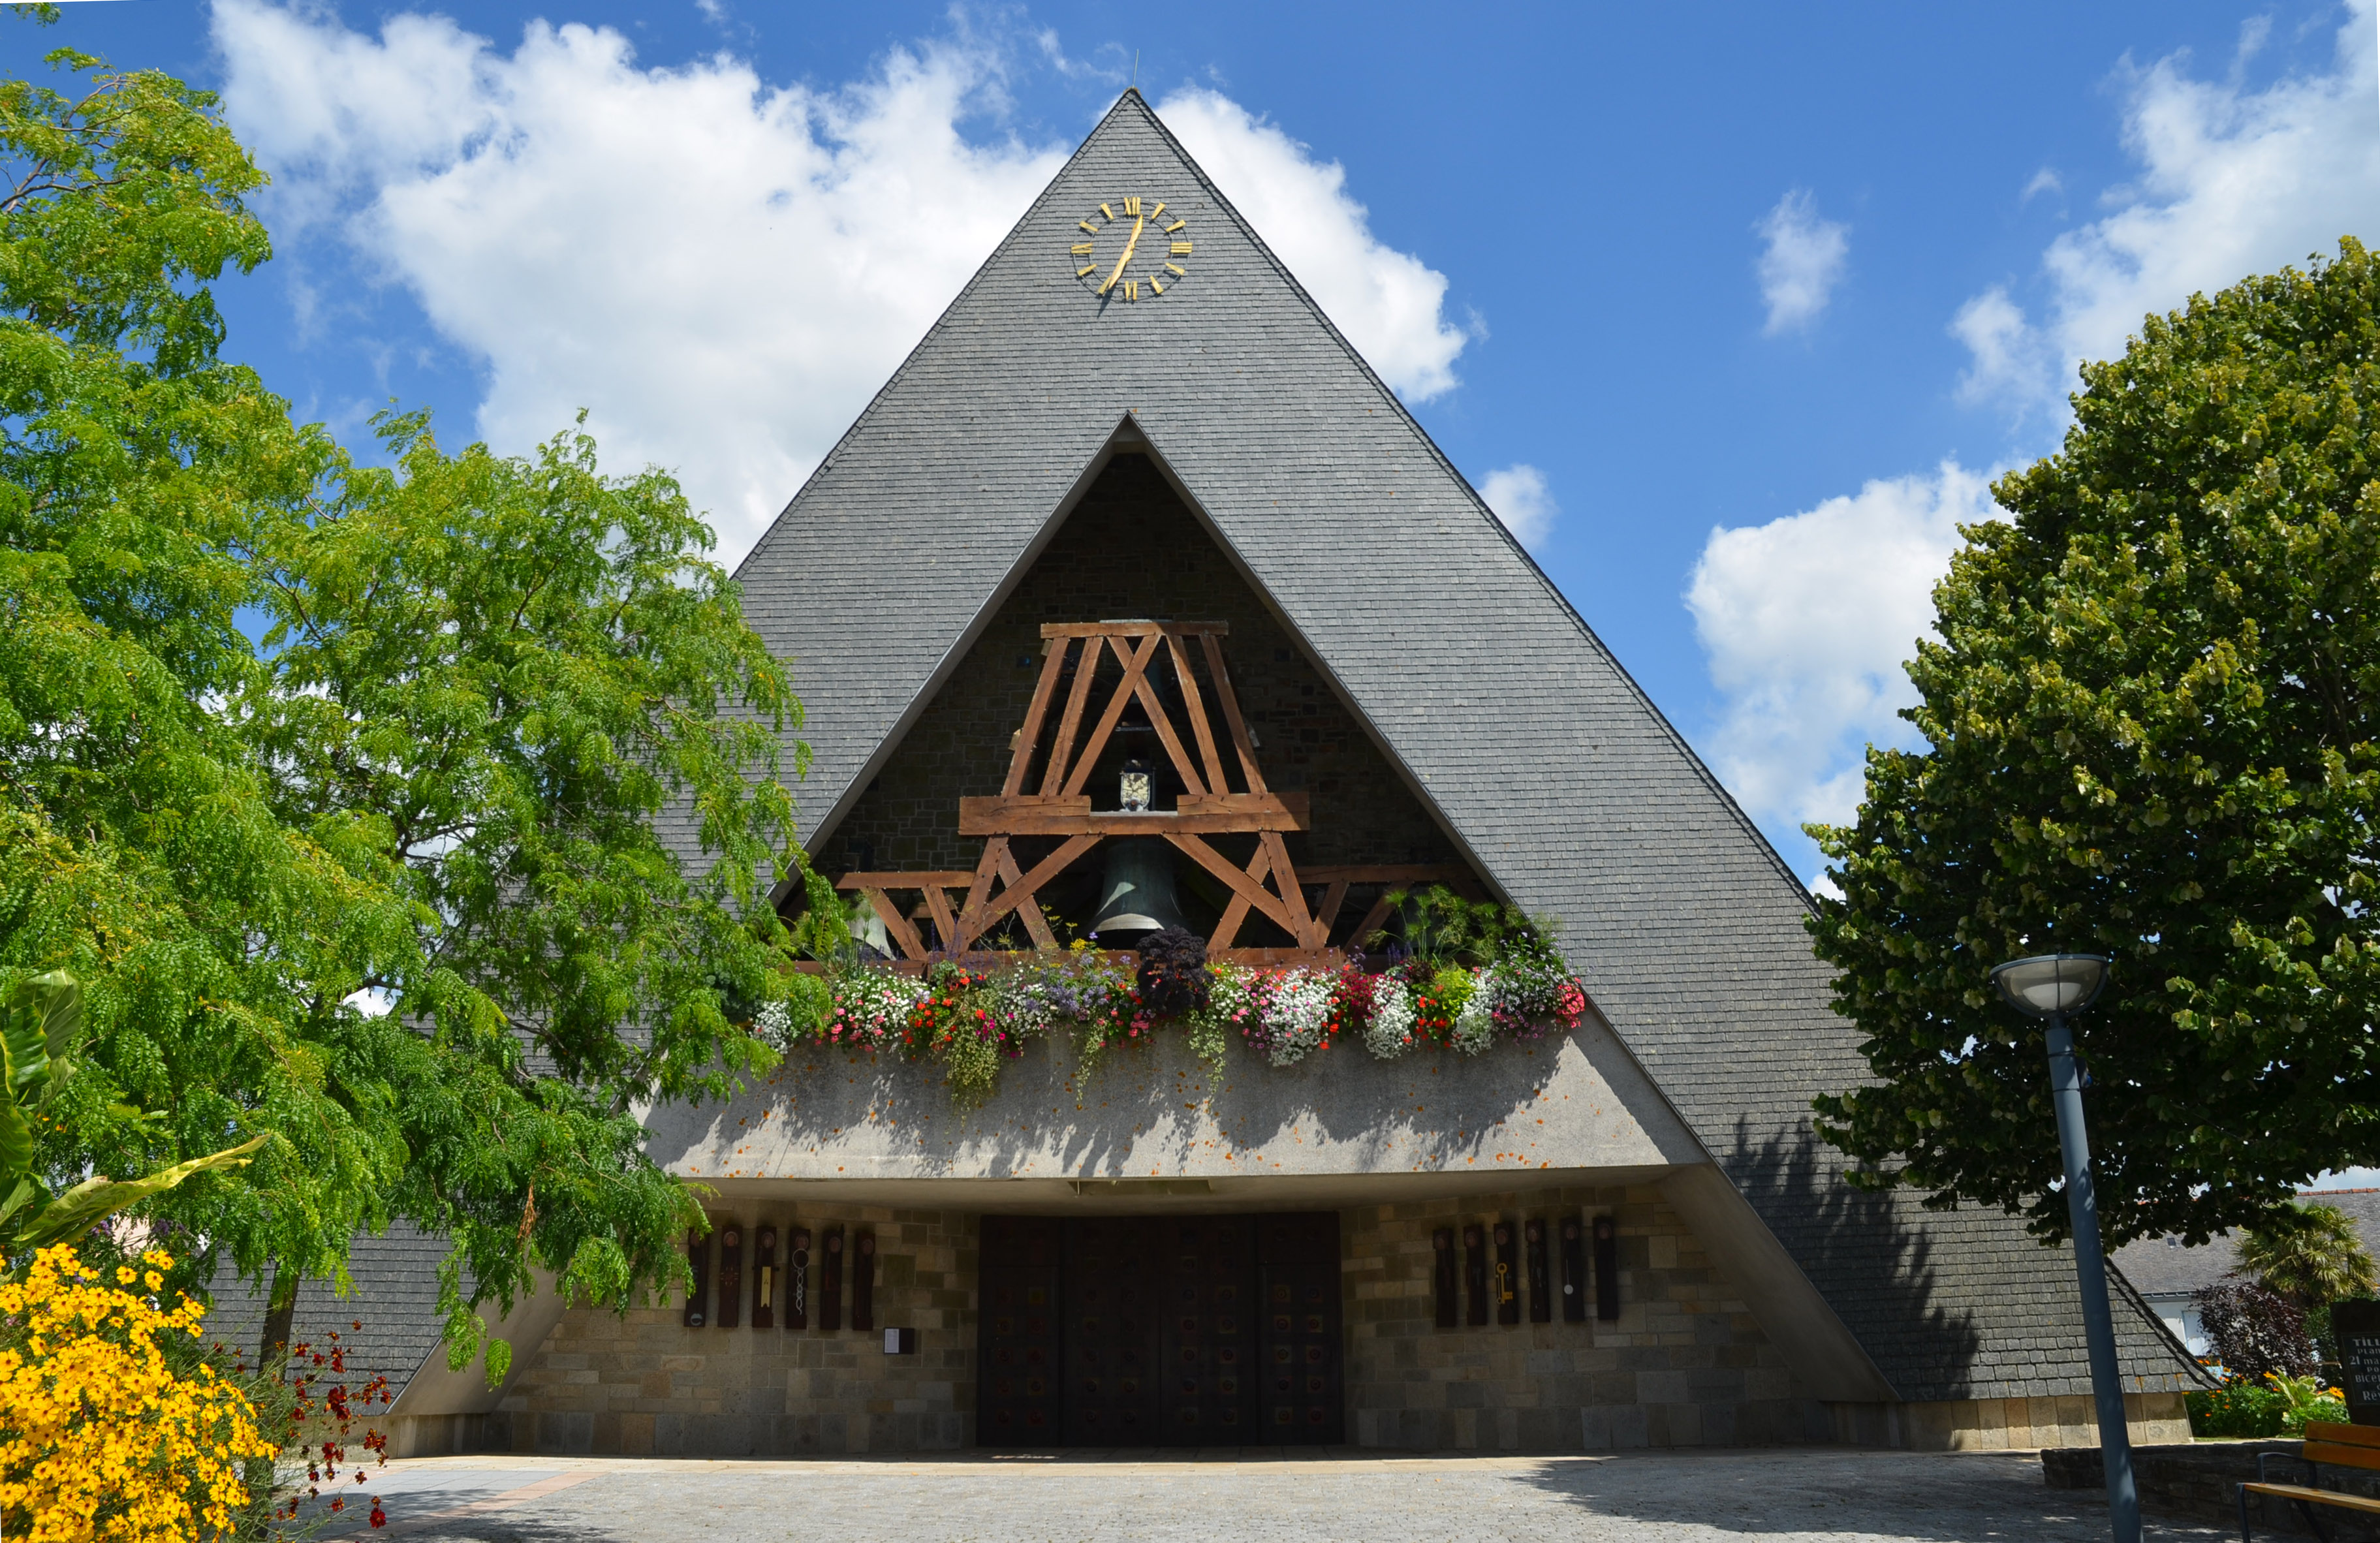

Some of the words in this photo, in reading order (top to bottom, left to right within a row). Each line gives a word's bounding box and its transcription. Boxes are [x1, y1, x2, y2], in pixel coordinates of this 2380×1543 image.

[1123, 197, 1140, 215] XII
[1170, 242, 1193, 253] III
[2349, 1355, 2360, 1365] 21
